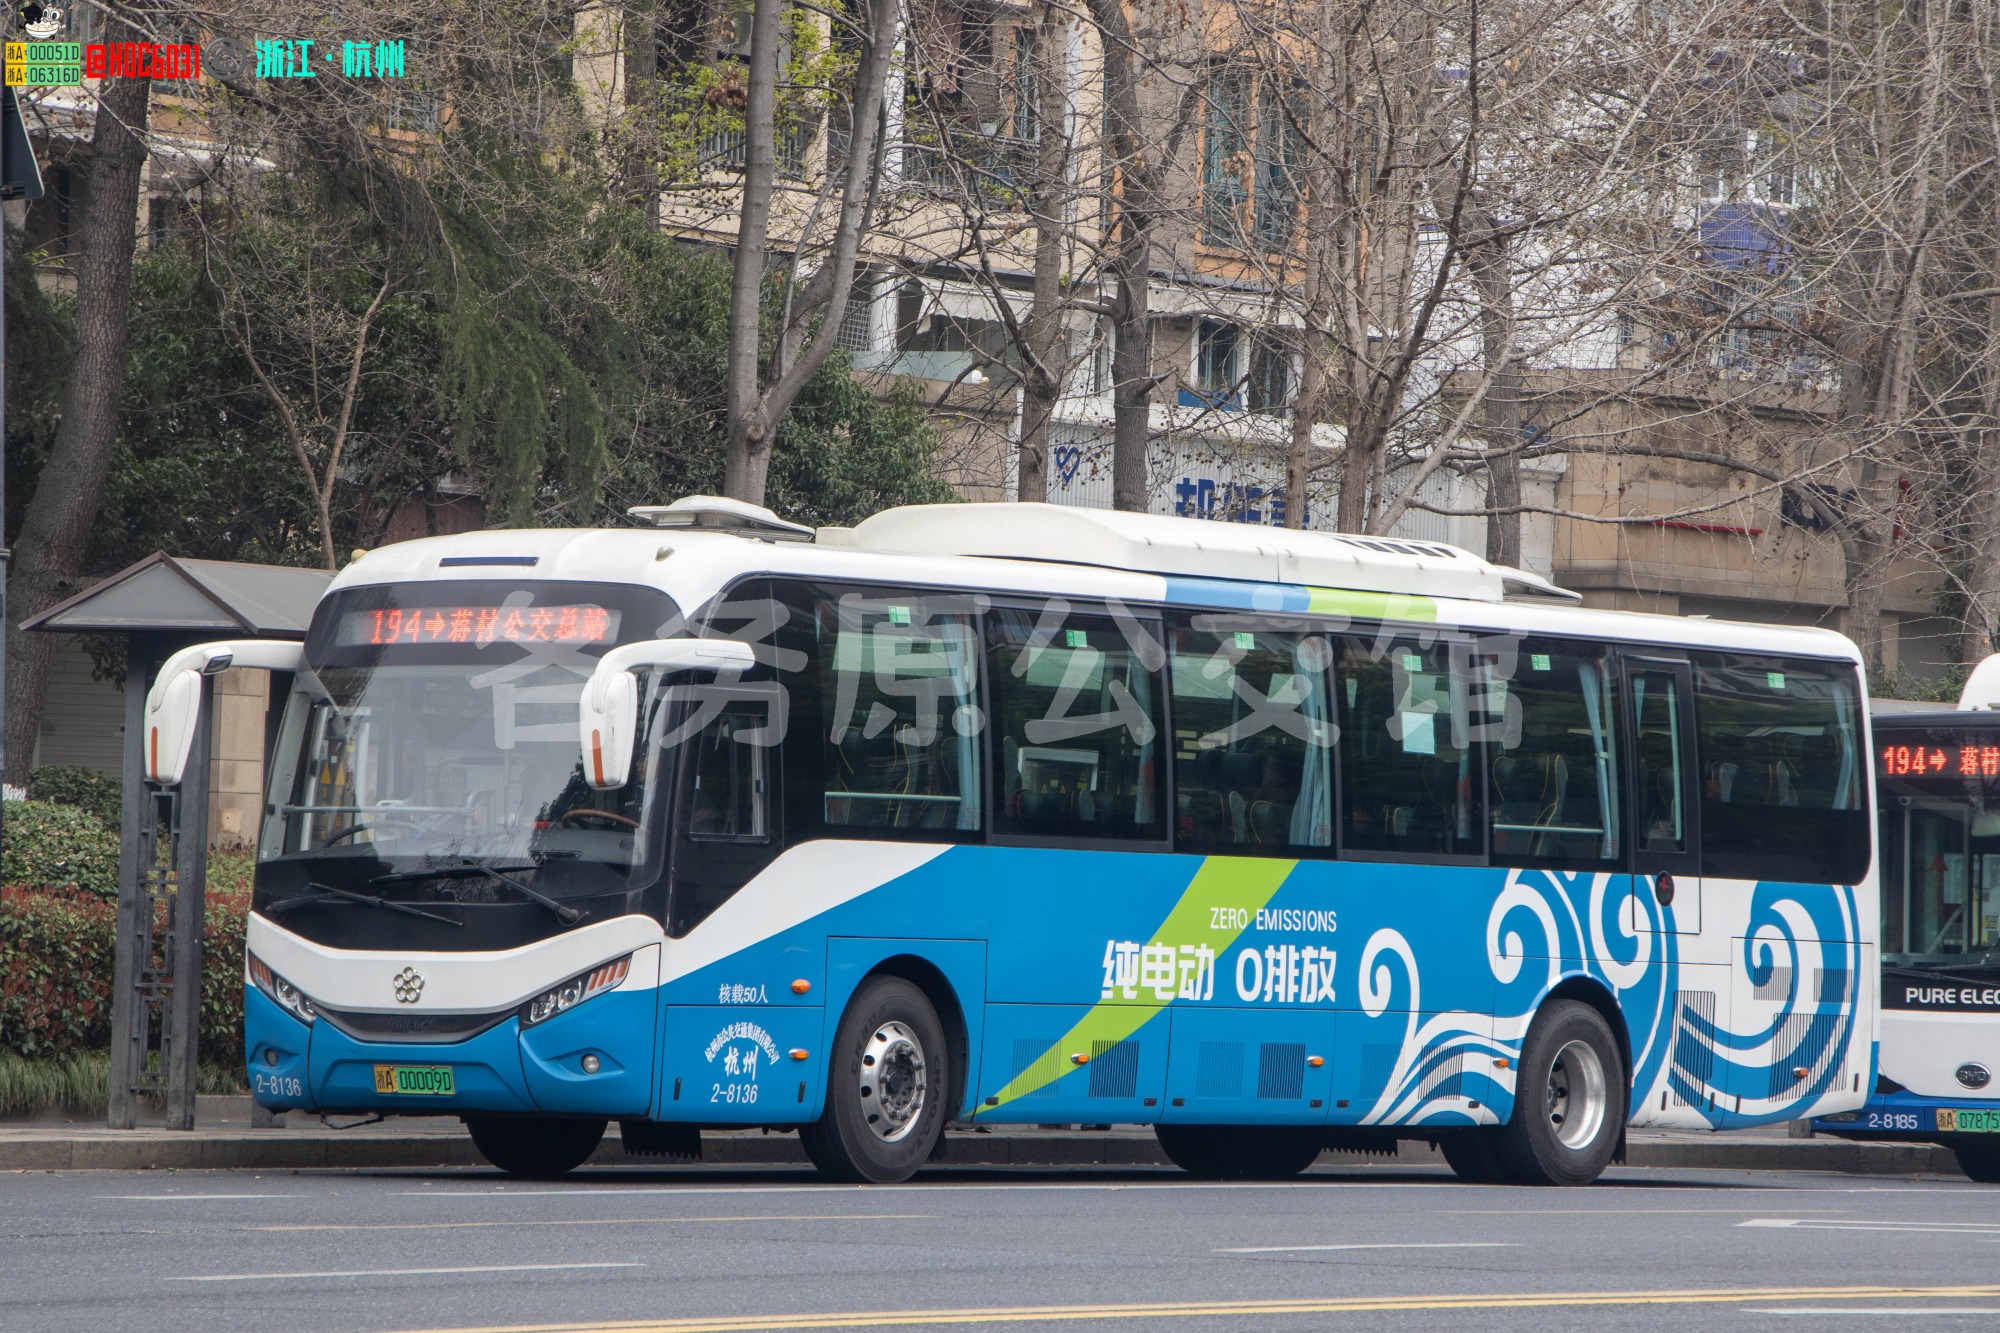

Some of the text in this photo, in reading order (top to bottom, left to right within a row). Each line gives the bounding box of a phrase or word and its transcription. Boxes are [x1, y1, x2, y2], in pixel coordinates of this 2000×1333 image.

[371, 610, 422, 645] 194
[1883, 746, 1926, 775] 194
[1210, 907, 1337, 932] ZERO EMISSIONS
[1101, 940, 1337, 1003] 纯电动 0排放
[718, 983, 768, 1005] 核载50人
[1906, 987, 1956, 1004] PURE
[724, 1045, 759, 1081] 杭州
[256, 1073, 302, 1097] 2-8136
[710, 1083, 758, 1104] 2-8136
[1868, 1113, 1918, 1130] 2-8185
[1937, 1112, 2000, 1129] 浙A07875
